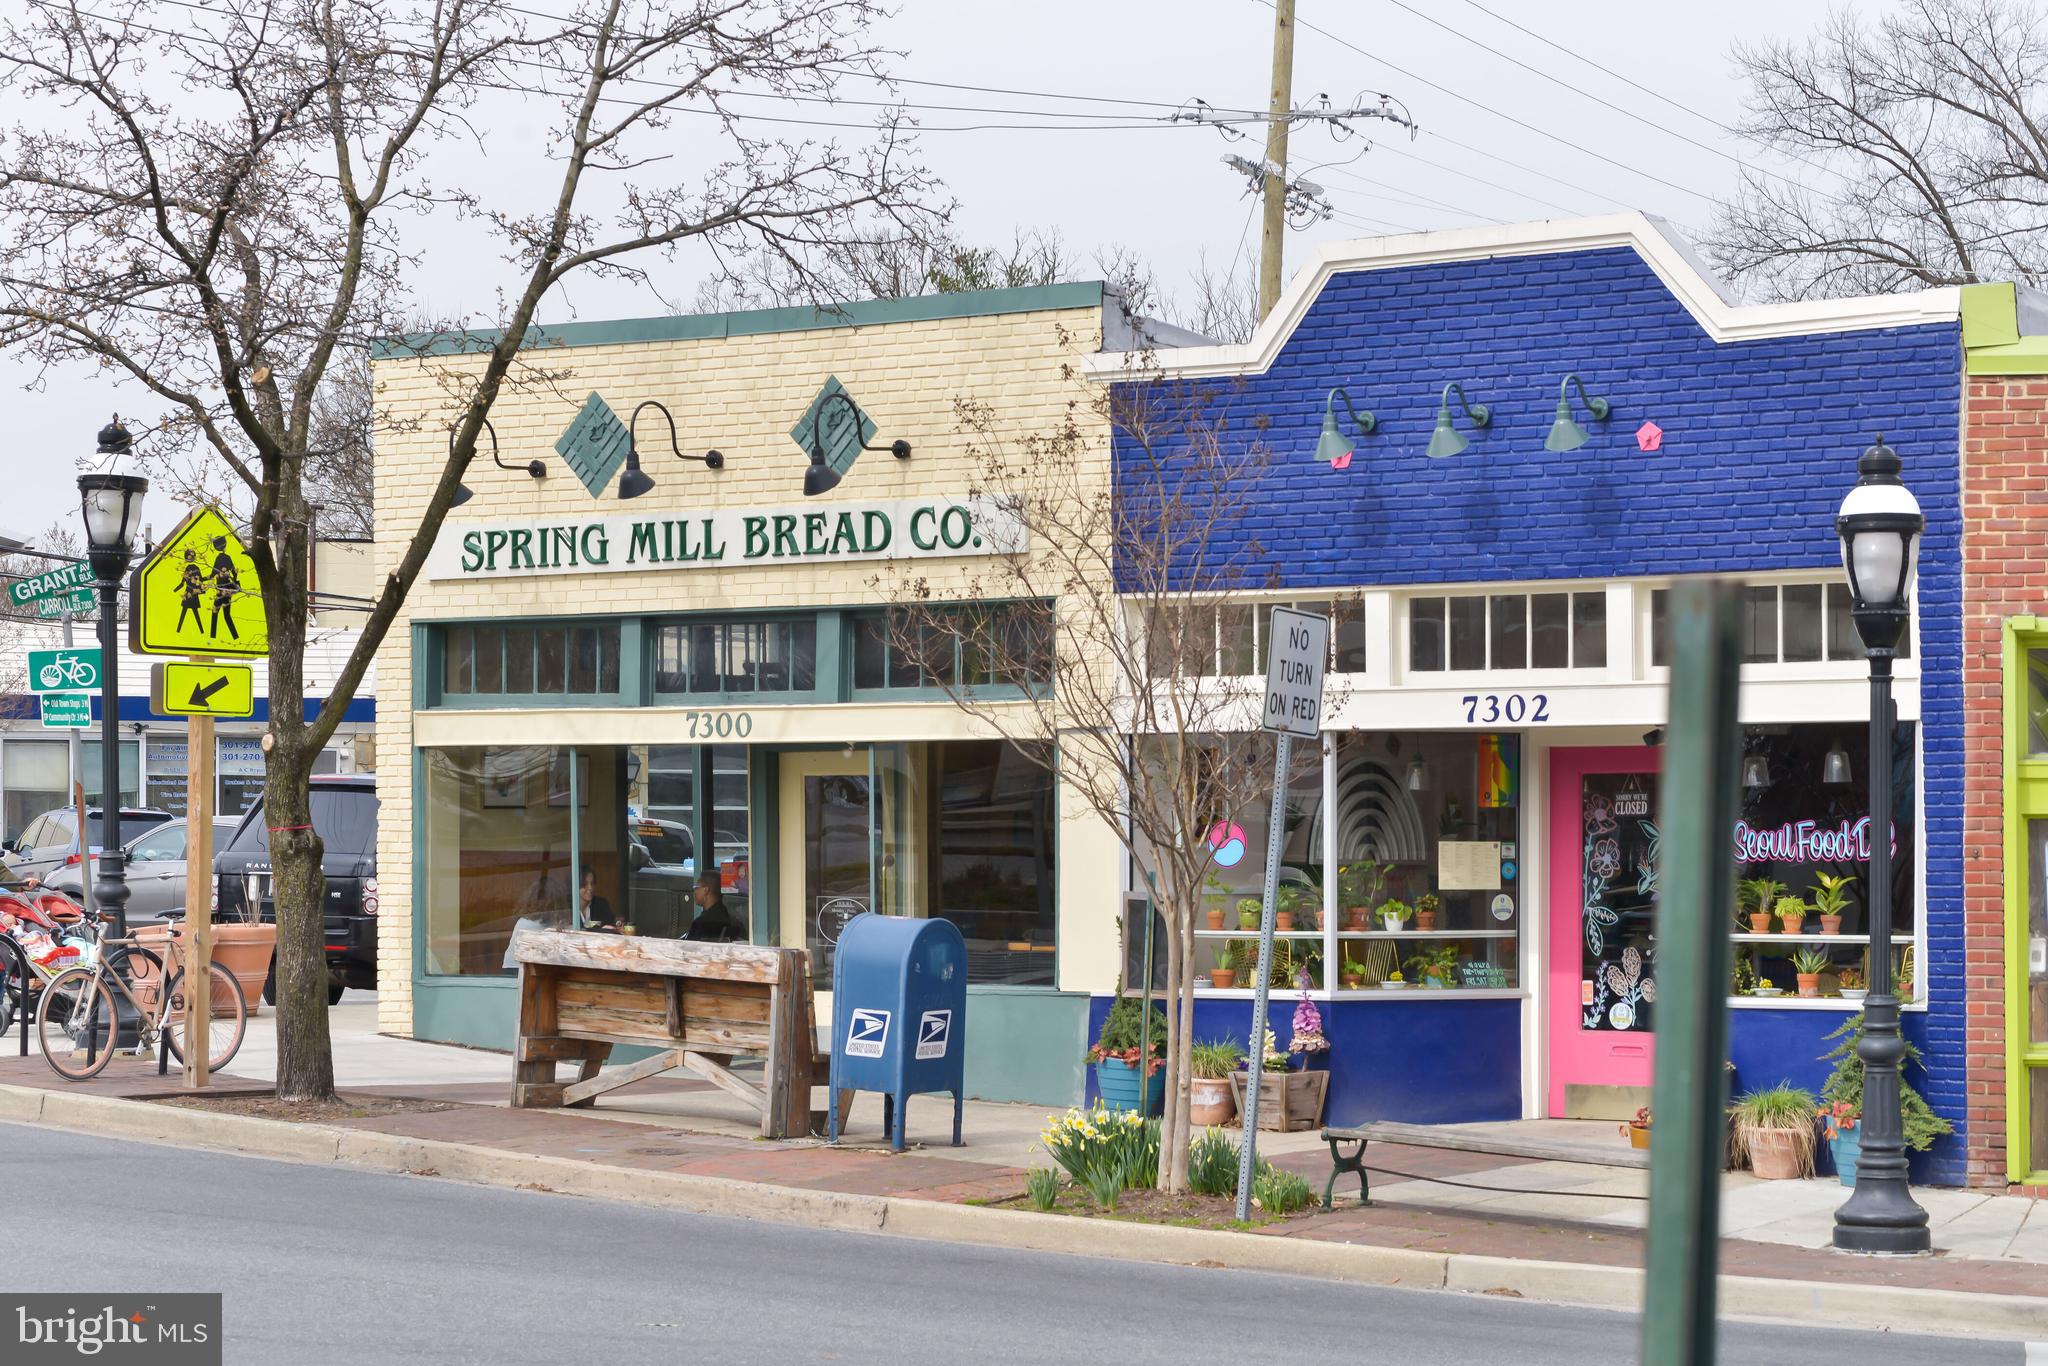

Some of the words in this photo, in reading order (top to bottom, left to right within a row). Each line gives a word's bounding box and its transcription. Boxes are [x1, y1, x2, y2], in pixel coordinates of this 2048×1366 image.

[461, 523, 610, 574] SPRING
[625, 518, 727, 564] MILL
[742, 510, 893, 559] BREAD
[909, 504, 983, 551] CO.
[15, 565, 77, 600] GRANT
[40, 597, 74, 615] CARROLL
[1289, 626, 1310, 651] NO
[1280, 659, 1313, 686] TURN
[1269, 692, 1287, 716] ON
[1292, 696, 1316, 721] RED
[1462, 694, 1550, 723] 7302
[686, 711, 753, 738] 7300
[1615, 801, 1648, 815] CLOSED
[1733, 819, 1795, 865] Seoul
[1794, 818, 1853, 863] Food
